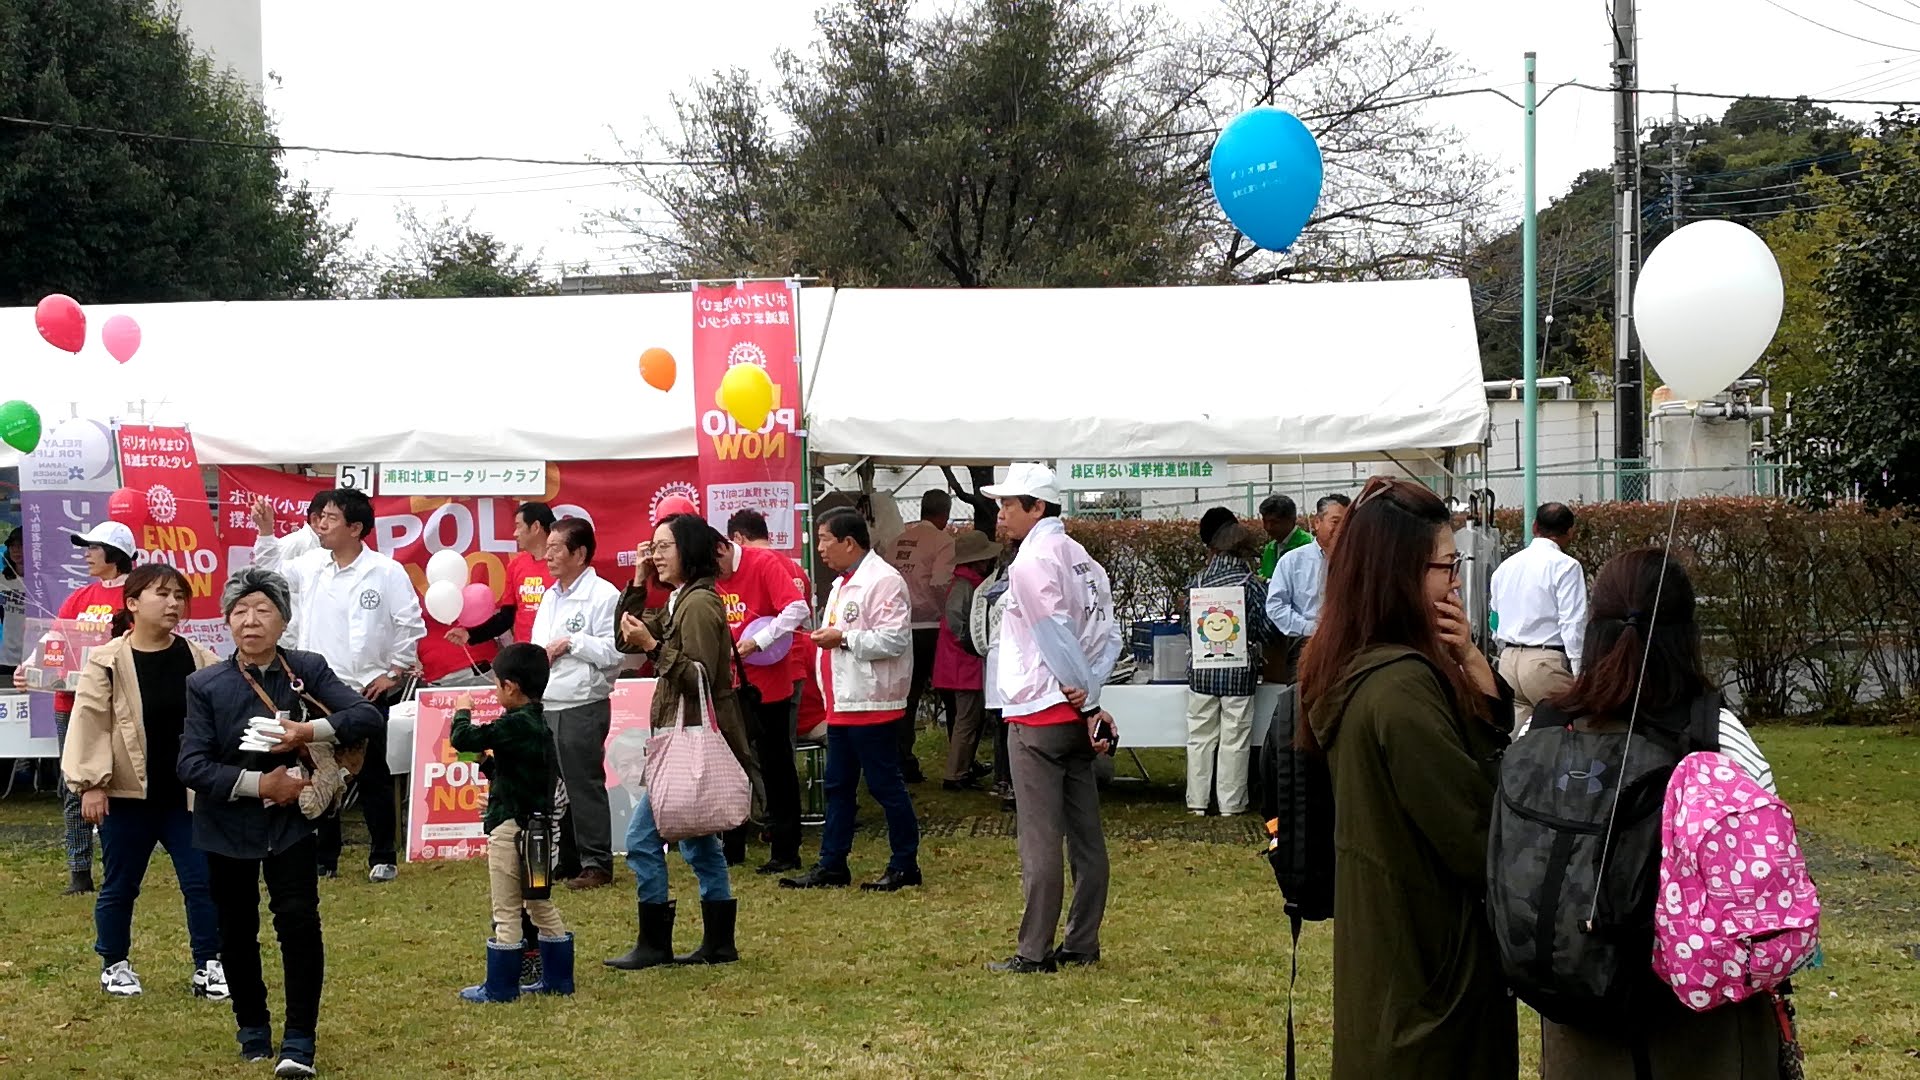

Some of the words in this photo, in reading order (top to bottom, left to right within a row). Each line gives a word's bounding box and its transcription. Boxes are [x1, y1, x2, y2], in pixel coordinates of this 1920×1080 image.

[122, 435, 190, 453] ポリオ(小児まひ)
[340, 465, 371, 490] 51
[383, 468, 542, 484] 浦和北東ロータリークラブ
[1070, 461, 1213, 479] 緑区明るい選挙推進協議会
[143, 524, 198, 551] END
[523, 576, 543, 586] END
[519, 585, 546, 595] POLIO
[76, 612, 113, 623] POLIO
[85, 604, 113, 615] END
[43, 654, 65, 662] POLIO
[433, 785, 489, 811] NO
